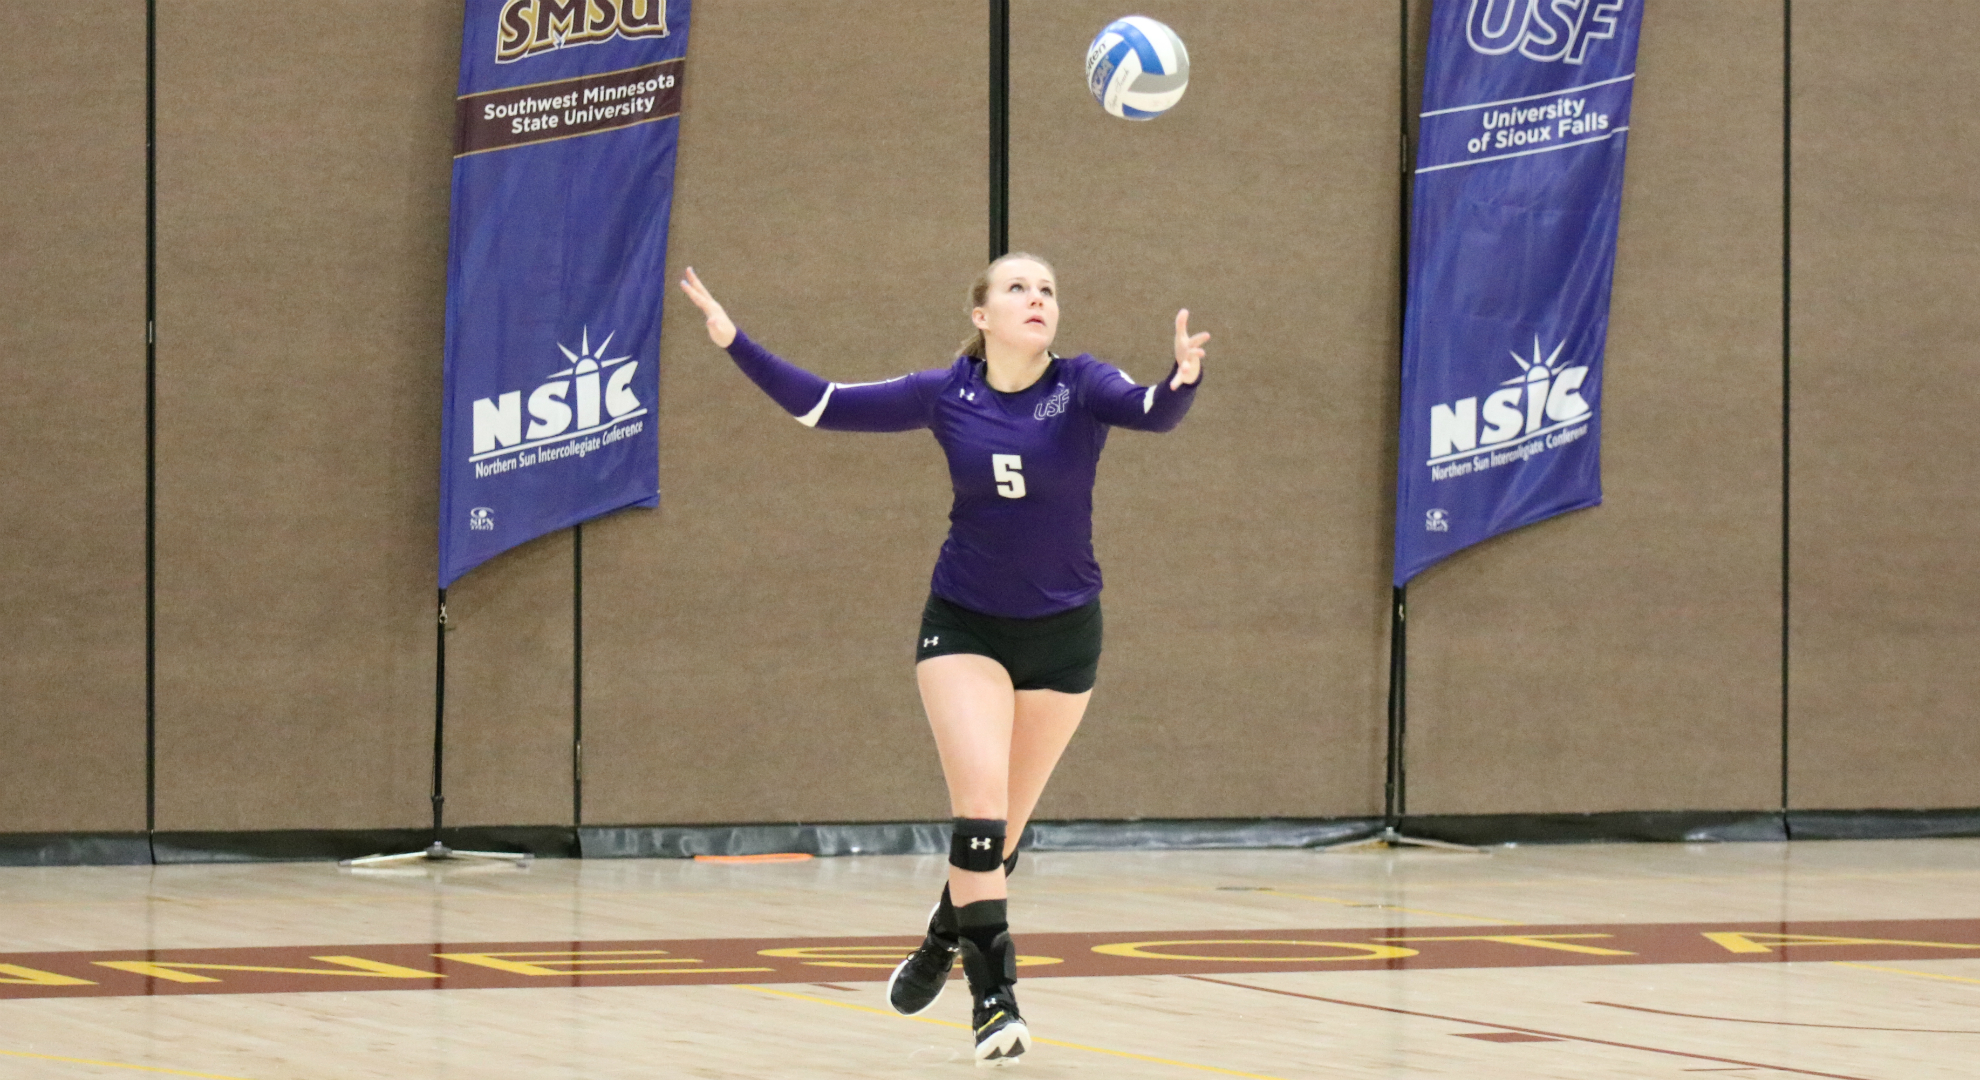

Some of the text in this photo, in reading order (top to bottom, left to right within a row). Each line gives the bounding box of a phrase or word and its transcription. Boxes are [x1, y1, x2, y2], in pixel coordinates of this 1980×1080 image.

[1466, 0, 1624, 64] USF
[484, 73, 675, 121] Southwest Minnesota
[511, 96, 655, 134] State University
[1483, 98, 1586, 130] University
[1467, 111, 1609, 153] of Sioux Falls
[473, 358, 641, 455] NSIC
[1034, 388, 1070, 420] USF
[1430, 365, 1589, 459] NSIC
[475, 420, 643, 480] Northern Sun Intercollegiate Conference
[1431, 460, 1472, 482] Northern
[1473, 455, 1490, 472] Sun
[992, 453, 1027, 499] 5
